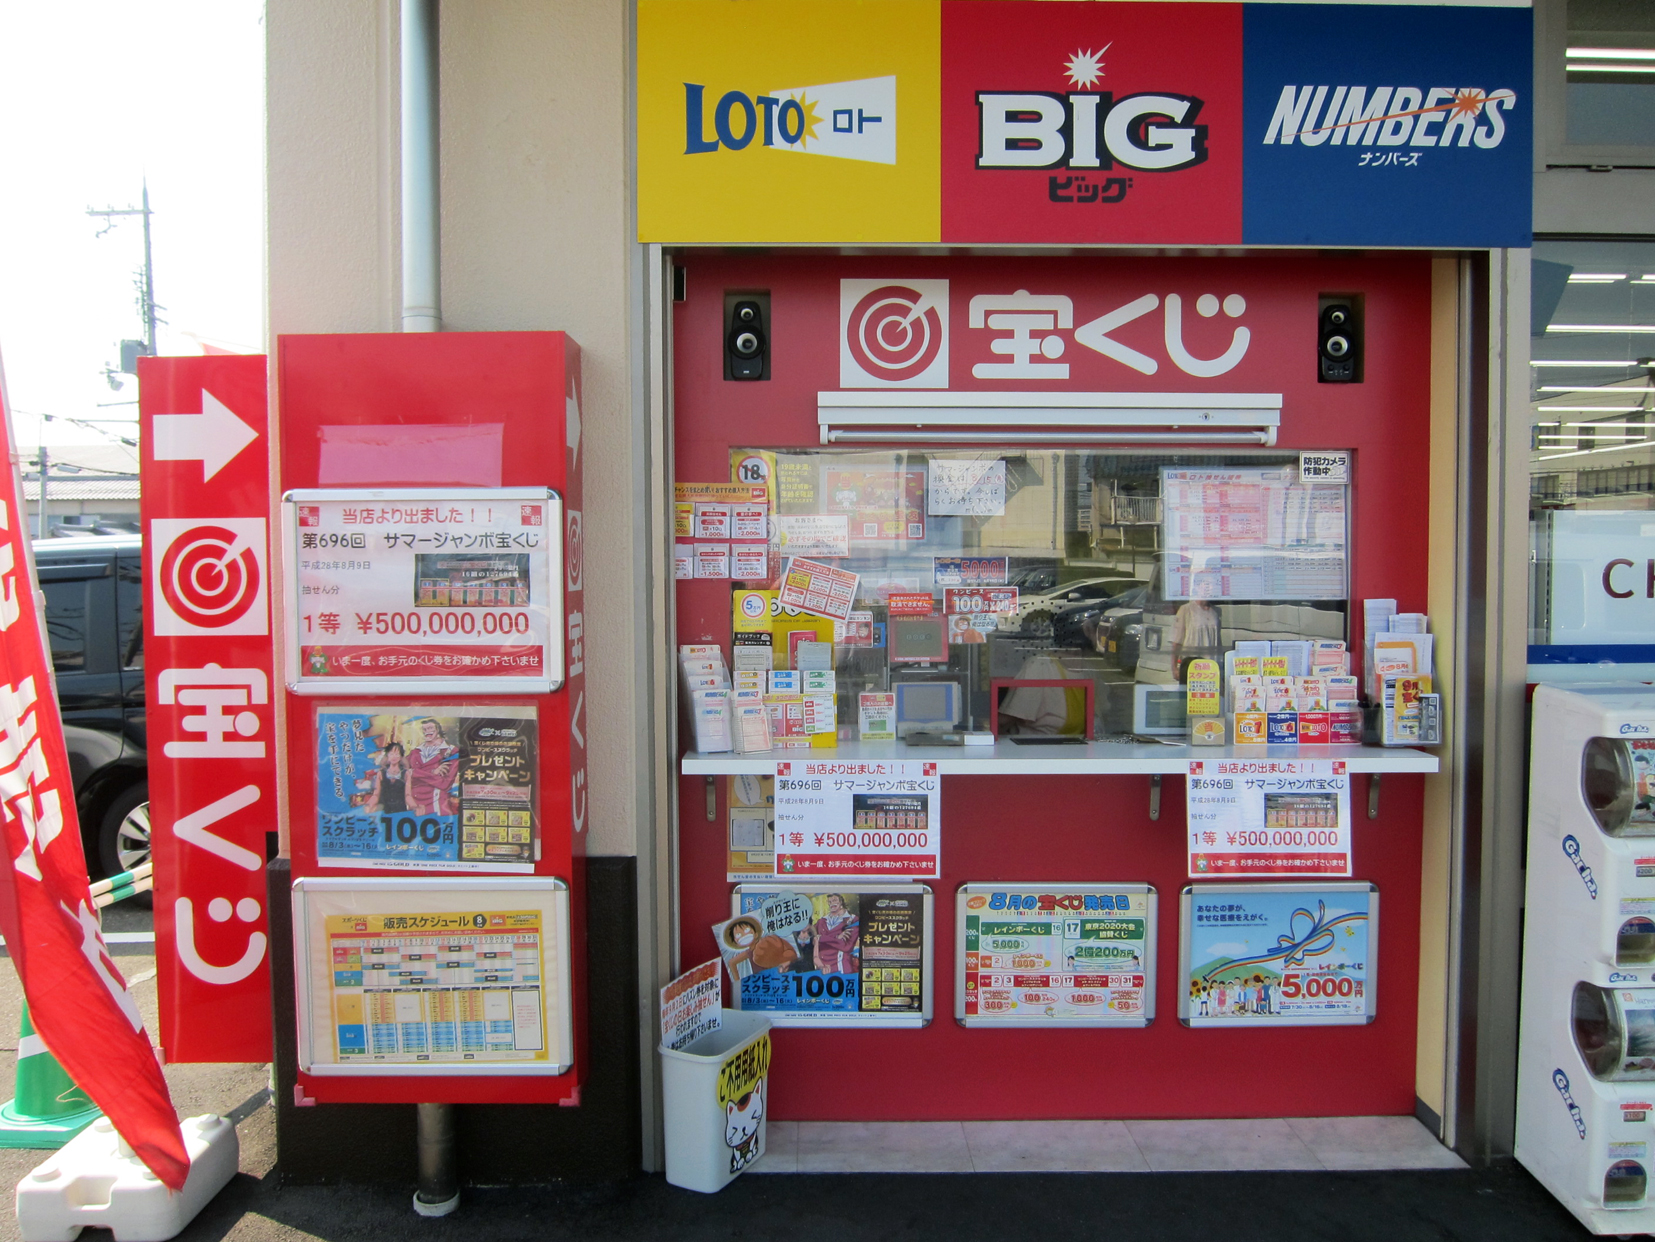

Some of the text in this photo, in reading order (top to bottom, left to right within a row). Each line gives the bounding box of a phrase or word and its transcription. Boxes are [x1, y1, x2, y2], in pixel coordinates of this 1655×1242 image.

[683, 82, 805, 155] LOTO
[1263, 86, 1517, 150] NUMBERS
[976, 88, 1208, 171] BIG
[1357, 151, 1423, 168] ナンバーズ
[1047, 175, 1134, 203] ビッグ
[969, 288, 1251, 379] 宝くじ
[1303, 456, 1347, 466] 防犯カメラ
[1303, 466, 1331, 476] 作動中
[302, 532, 540, 549] 第696回 サマージャンボ宝くじ
[301, 560, 371, 570] 平成28年8月9日
[356, 611, 530, 636] ¥500,000,000
[332, 655, 540, 668] いま一度、お手元のくじ券をお確かめ下さいませ
[1189, 671, 1217, 680] スタンプ
[470, 754, 526, 768] プレゼント
[463, 768, 532, 783] キャンペーン
[778, 779, 935, 791] 第696回 サマージャンボ宝くじ
[1191, 778, 1345, 790] 第696回 サマージャンボ宝くじ
[778, 797, 824, 805] 平成28年8月9日
[157, 662, 269, 985] 宝くじ
[321, 825, 379, 838] スクラッチ
[814, 832, 928, 849] ¥500,000,000
[1226, 830, 1338, 848] ¥500,000,000
[988, 892, 1131, 912] 8月の宝くじ発売日
[1196, 904, 1246, 913] あなたの夢が、
[765, 898, 801, 920] 削り王に
[383, 915, 470, 930] 販売スケジュール
[1196, 913, 1269, 922] 幸せな医療をえがく。
[868, 921, 916, 933] プレゼント
[993, 925, 1045, 934] レインボーくじ
[1052, 924, 1061, 932] 16
[1066, 923, 1079, 933] 17
[1084, 922, 1136, 931] 東京2020大会
[863, 933, 920, 945] キャンペーン
[1318, 962, 1364, 971] レインボーくじ
[742, 983, 790, 994] スクラッチ
